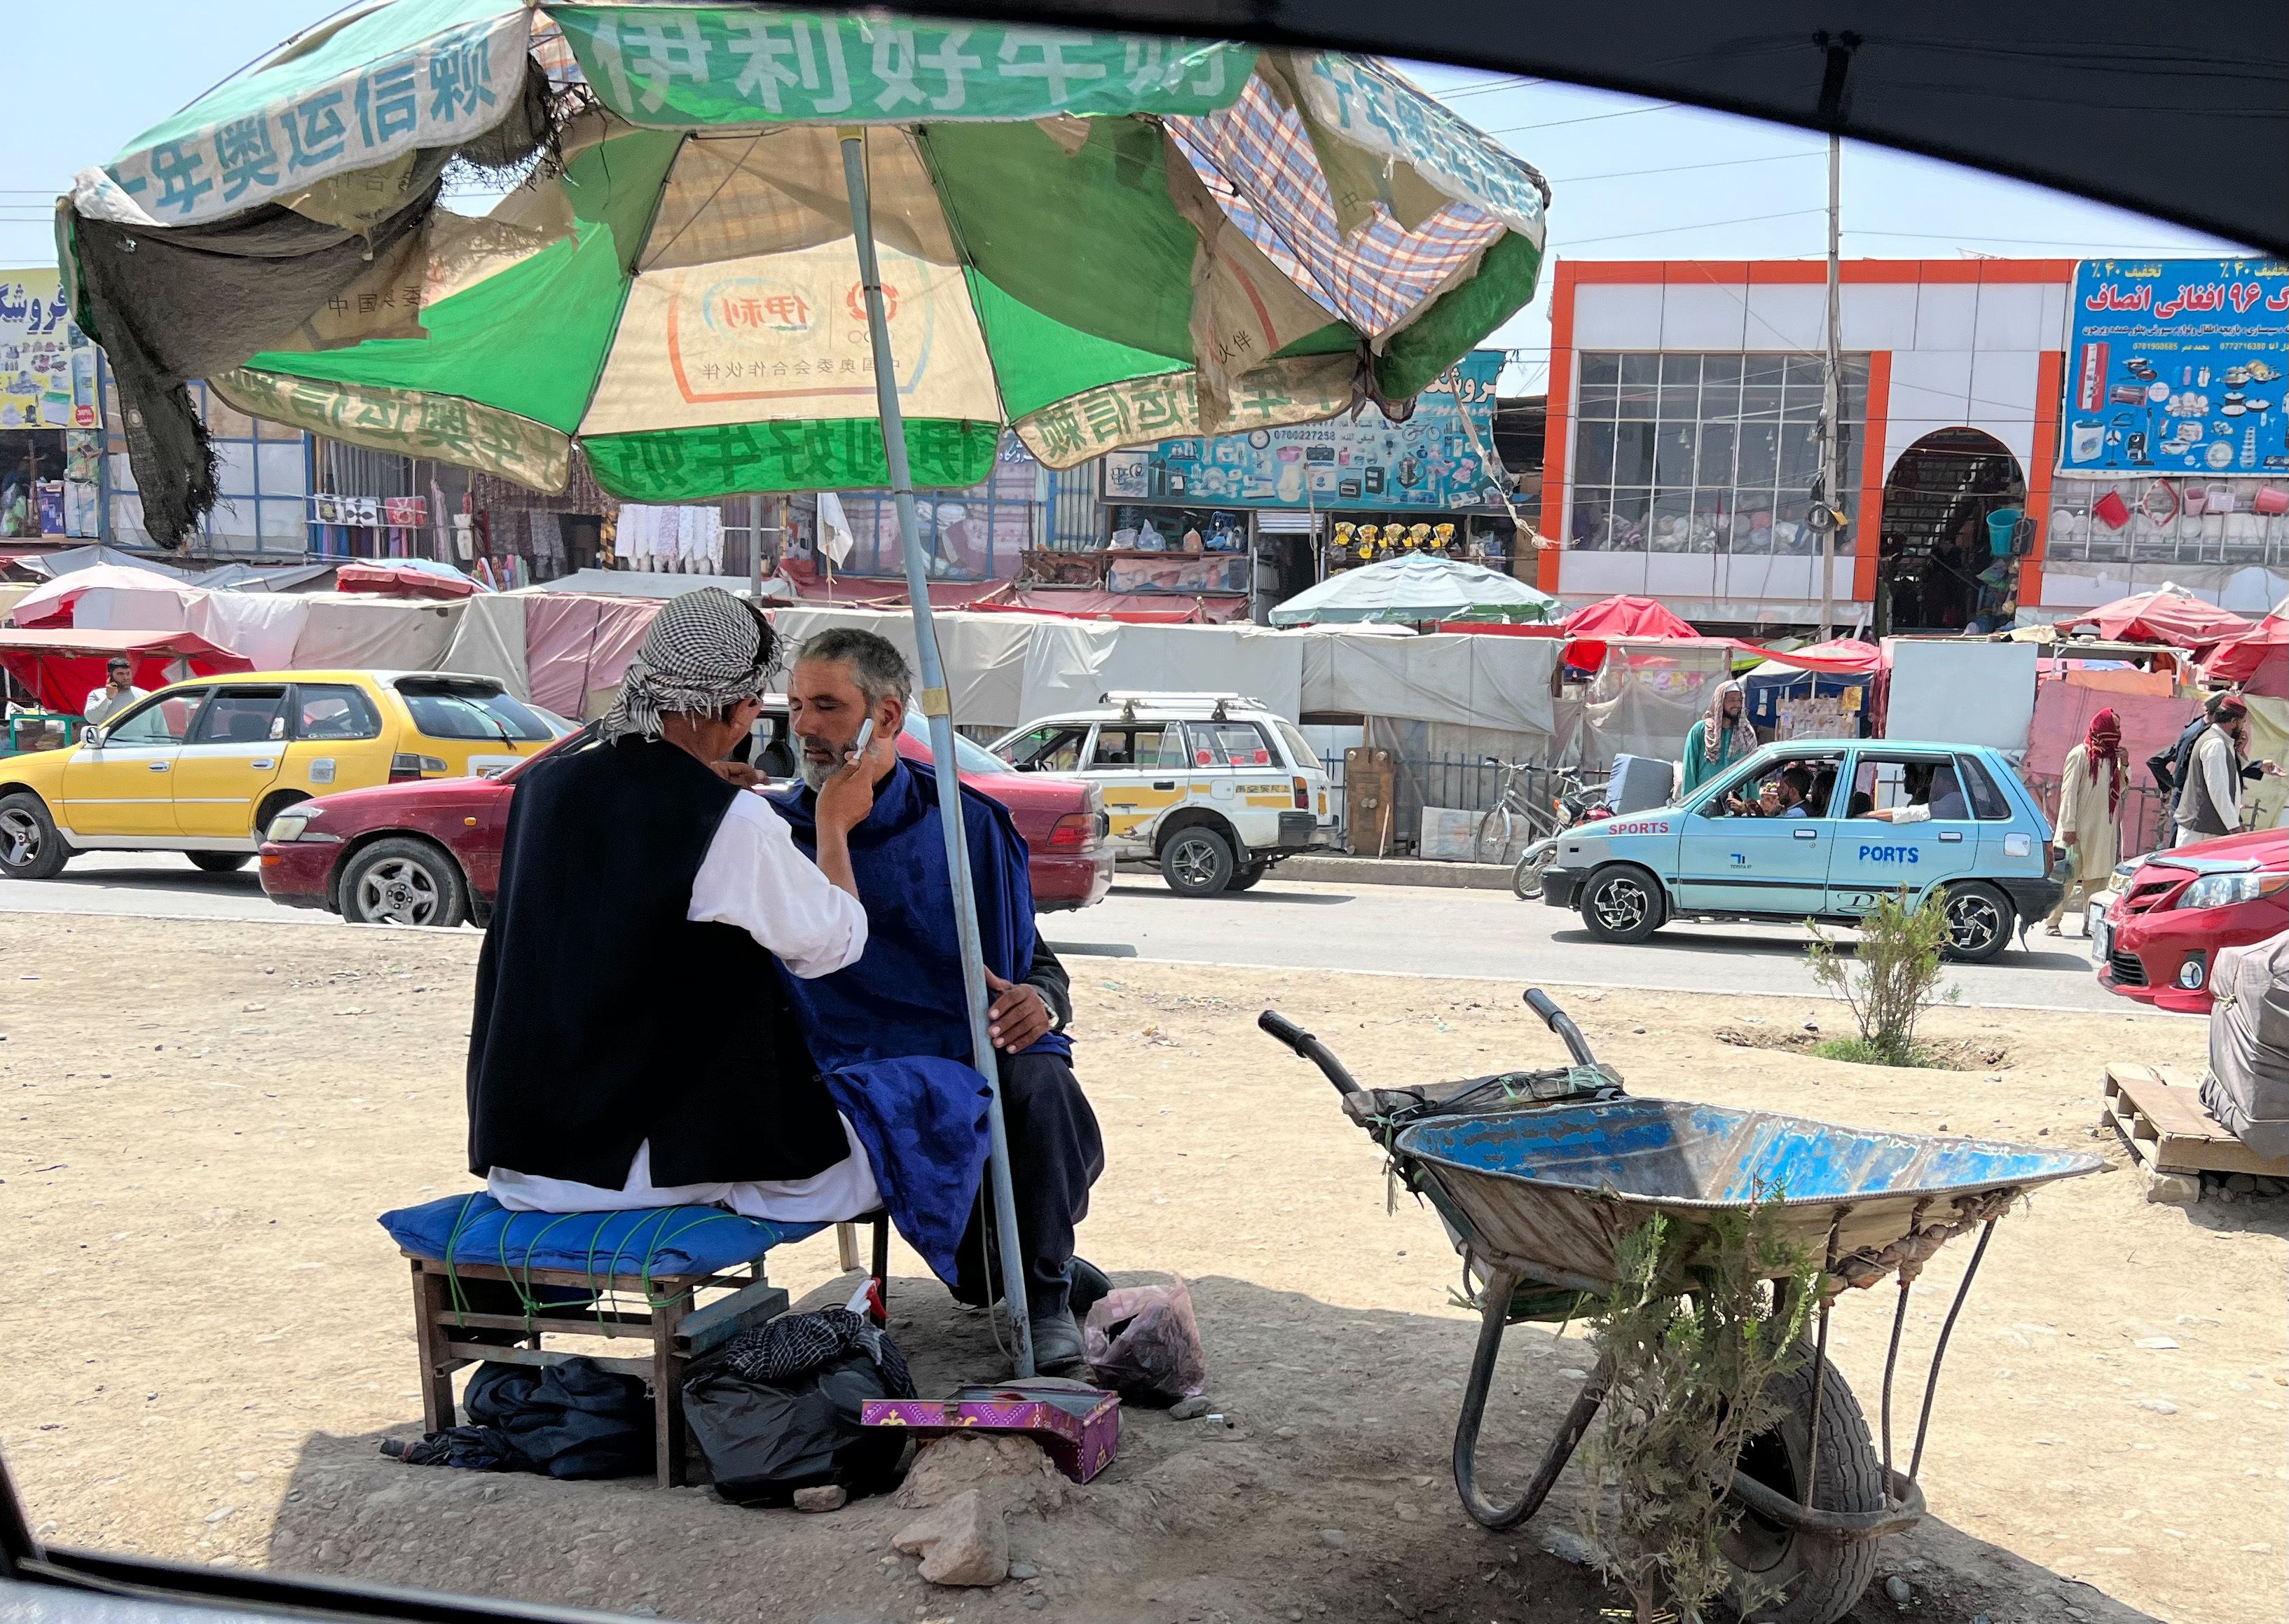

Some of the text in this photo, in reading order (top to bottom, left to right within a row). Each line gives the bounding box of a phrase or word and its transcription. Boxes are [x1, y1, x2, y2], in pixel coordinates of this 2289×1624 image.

[2085, 282, 2152, 312] انصاف
[2154, 282, 2226, 319] افغانی
[1609, 822, 1669, 834] SPORTS
[1859, 845, 1919, 865] PORTS
